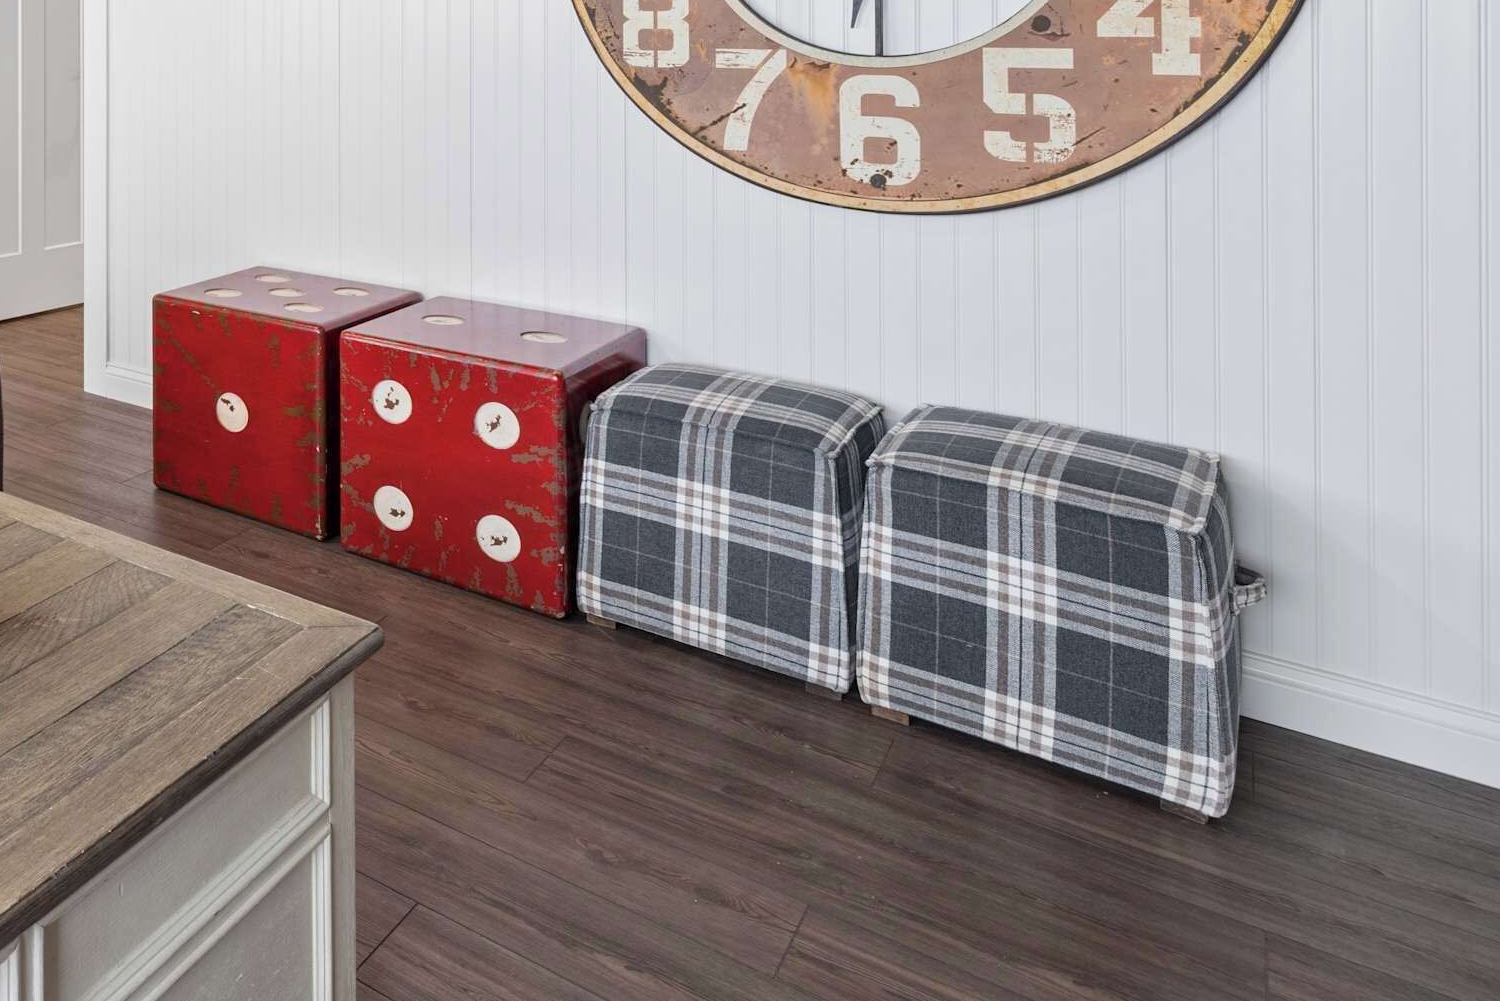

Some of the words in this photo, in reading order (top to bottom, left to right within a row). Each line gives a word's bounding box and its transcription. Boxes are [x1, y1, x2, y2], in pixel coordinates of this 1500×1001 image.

[714, 47, 787, 152] 7
[838, 73, 922, 187] 6
[982, 46, 1077, 164] 5
